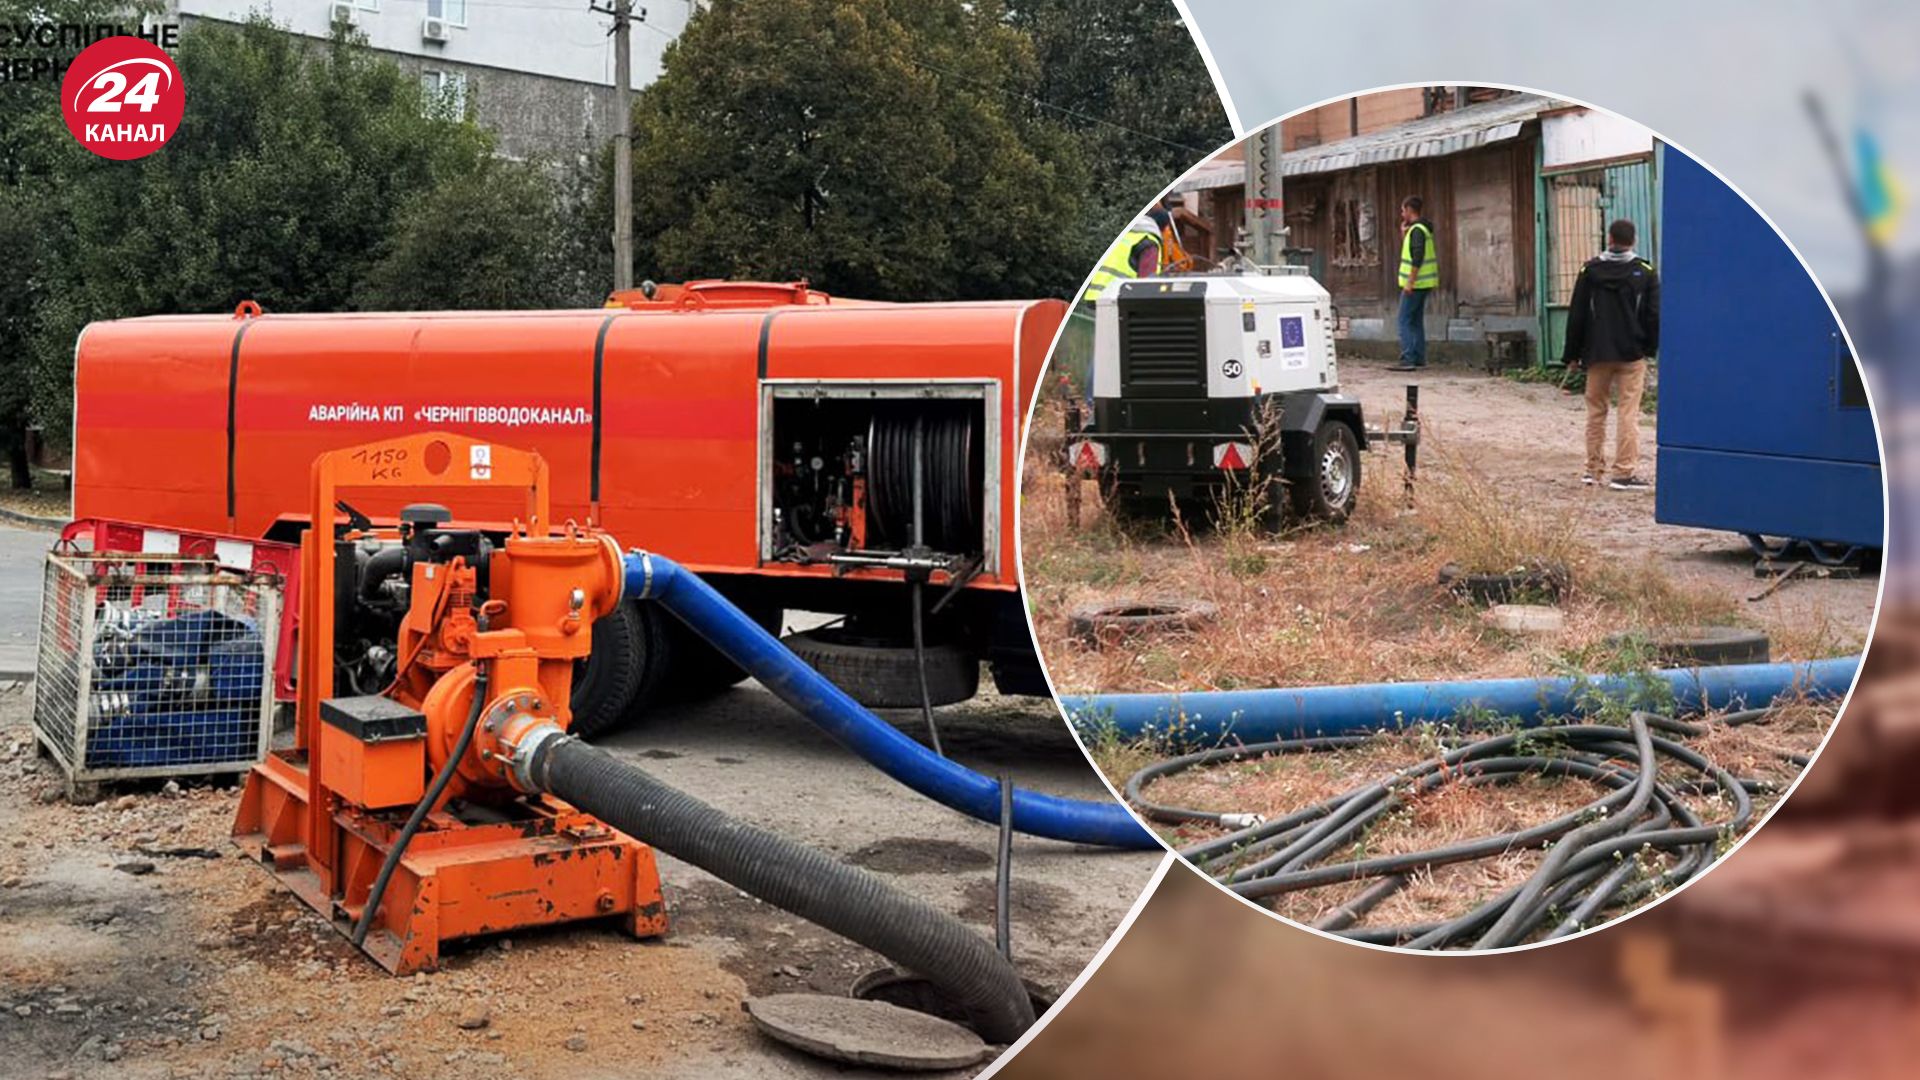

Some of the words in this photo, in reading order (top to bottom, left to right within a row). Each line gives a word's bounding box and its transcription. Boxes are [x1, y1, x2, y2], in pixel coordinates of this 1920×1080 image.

[1224, 362, 1241, 375] 50
[309, 402, 380, 421] АВАРІЙНА
[383, 405, 404, 421] КП
[413, 405, 593, 426] «ЧЕРНІГІВВОДОКАНАЛ»
[351, 449, 408, 464] 1150
